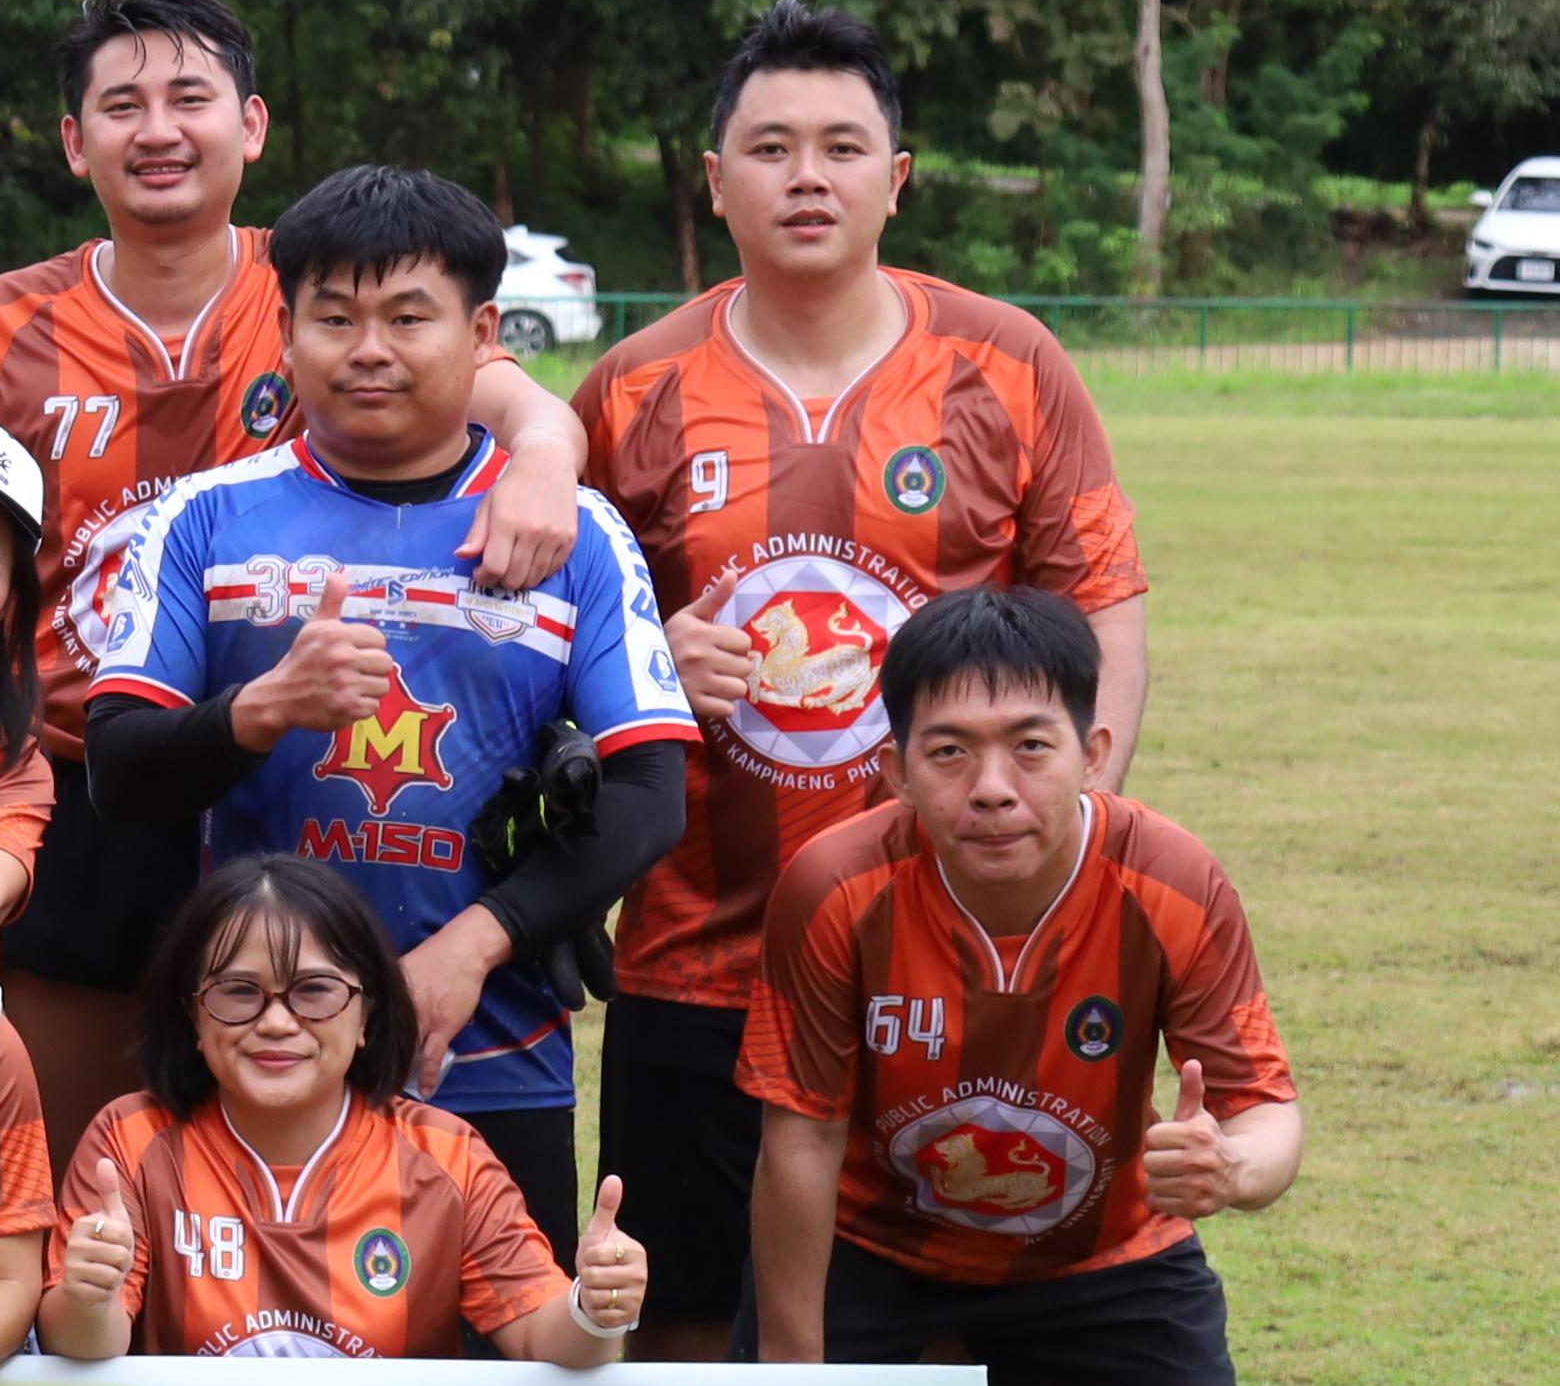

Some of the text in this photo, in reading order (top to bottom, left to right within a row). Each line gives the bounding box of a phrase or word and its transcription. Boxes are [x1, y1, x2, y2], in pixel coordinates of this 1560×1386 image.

[43, 394, 120, 460] 77
[690, 450, 728, 514] 9
[752, 533, 929, 610] ADMINISTRATIO
[340, 710, 429, 775] M
[727, 747, 836, 790] KAMPHAENG
[296, 817, 466, 873] M-150
[866, 994, 945, 1060] 64
[875, 1076, 1111, 1147] PUBLIC ADMINISTRATION
[174, 1209, 247, 1282] 48
[245, 1309, 385, 1359] ADMINISTRA
